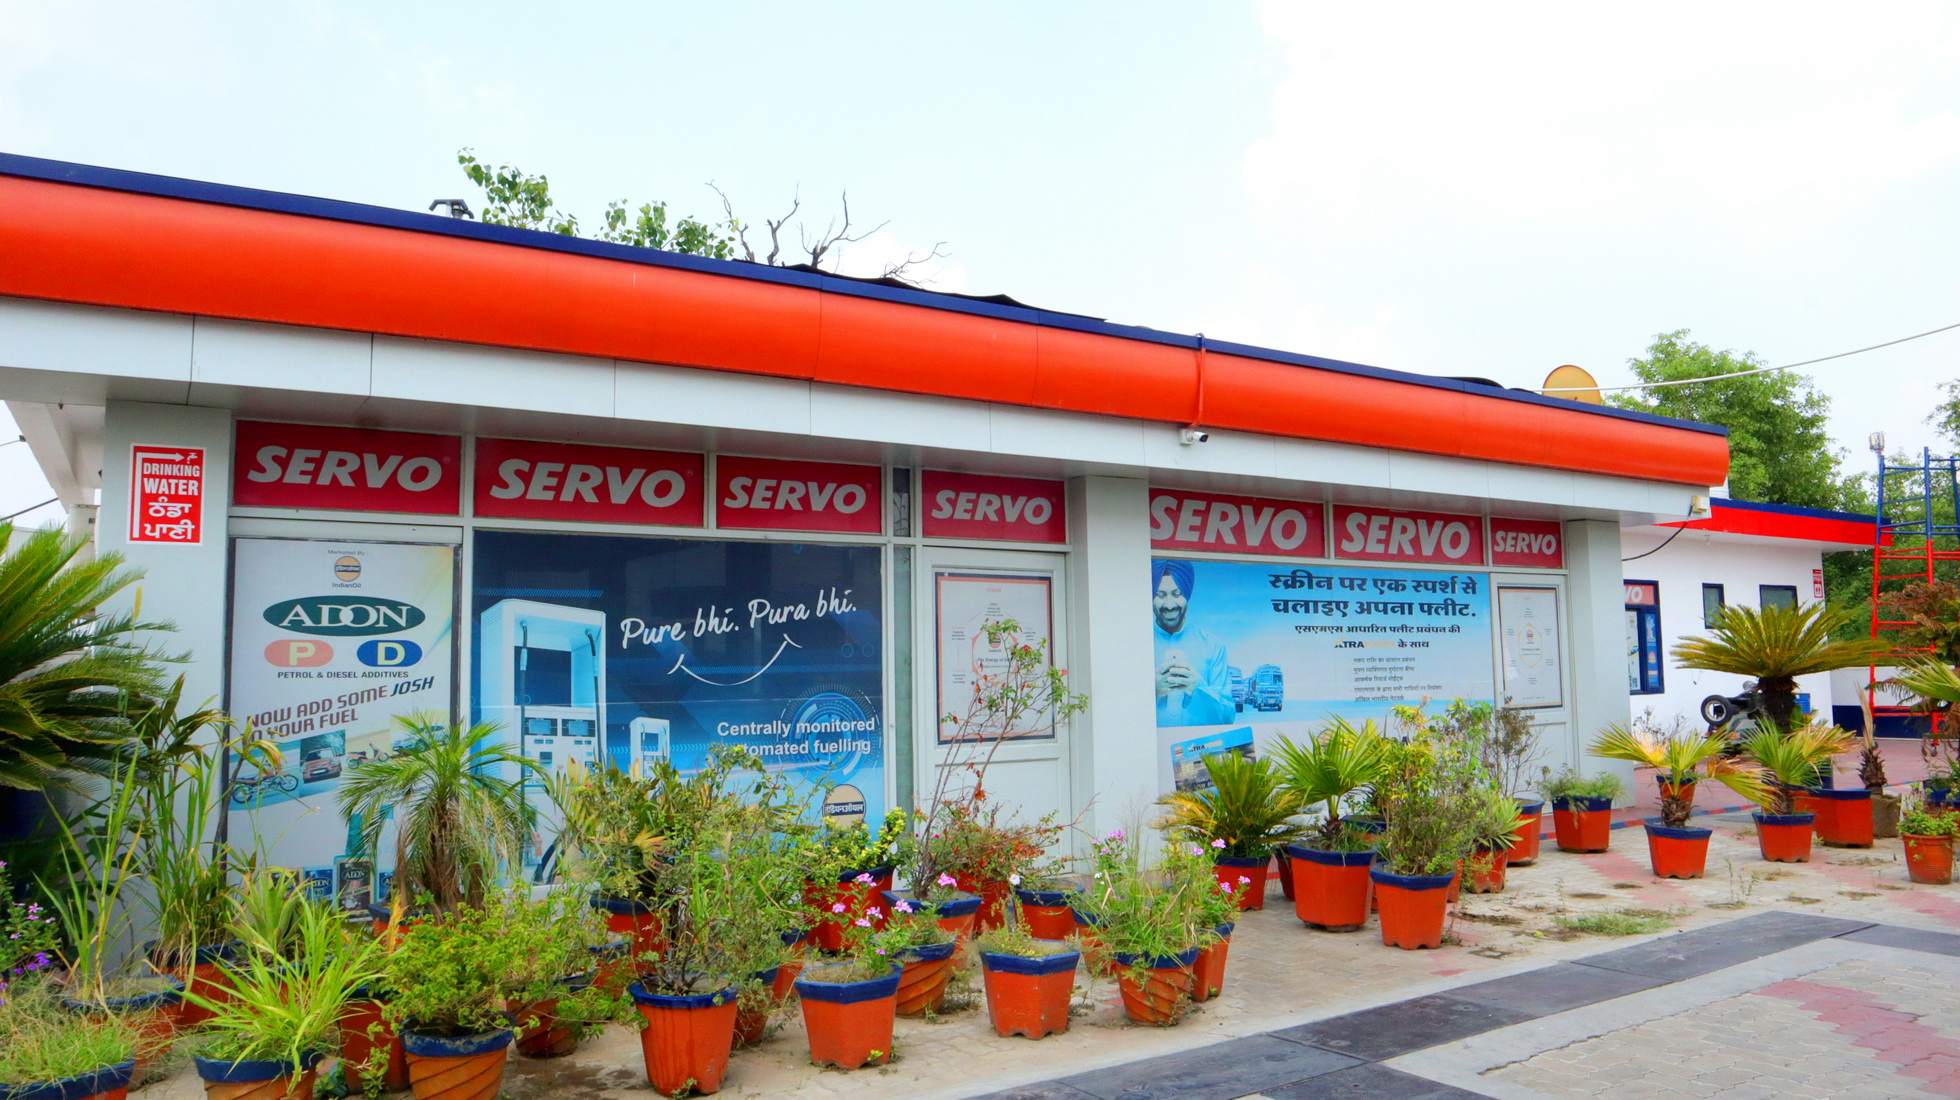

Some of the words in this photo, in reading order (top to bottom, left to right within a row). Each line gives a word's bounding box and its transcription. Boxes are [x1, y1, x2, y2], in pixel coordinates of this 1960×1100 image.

[143, 462, 200, 477] DRINKING
[247, 445, 442, 492] SERVO
[143, 477, 199, 496] WATER
[489, 458, 686, 508] SERVO
[723, 476, 867, 514] SERVO
[148, 496, 193, 518] ਠੰਡਾ
[930, 489, 1052, 525] SERVO
[144, 519, 195, 540] ਪਾਣੀ
[1150, 495, 1307, 550] SERVO
[1340, 512, 1471, 559] SERVO
[1493, 530, 1557, 555] SERVO
[1268, 569, 1333, 591] स्क्रीन
[1338, 576, 1368, 592] पर
[1372, 578, 1407, 595] एक
[1411, 575, 1458, 595] स्पर्श
[1461, 575, 1477, 595] से
[278, 604, 411, 628] ADON
[620, 617, 686, 649] Pure
[693, 605, 739, 637] bhi.
[748, 598, 811, 629] Pura
[816, 586, 857, 618] bhi.
[1271, 599, 1349, 618] चलाइए
[1354, 601, 1414, 616] अपना
[1419, 598, 1477, 617] फ्लीट.
[1294, 625, 1343, 634] एसएमएस
[1346, 624, 1387, 634] आधारित
[1416, 624, 1446, 634] प्रबंधन
[1448, 624, 1461, 634] की
[288, 642, 316, 666] P
[376, 642, 406, 666] D
[1398, 639, 1408, 649] के
[1409, 641, 1430, 649] साथ
[277, 671, 314, 679] PETROL
[316, 671, 324, 679] &
[326, 671, 358, 679] DIESEL
[361, 671, 409, 679] ADDITIVES
[247, 706, 291, 728] NOW
[297, 698, 333, 718] ADD
[337, 685, 388, 709] SOME
[390, 676, 434, 697] JOSH
[267, 717, 314, 740] YOUR
[320, 708, 358, 729] FUEL
[717, 720, 792, 738] Centrally
[796, 717, 875, 734] monitored
[814, 738, 871, 756] fuelling
